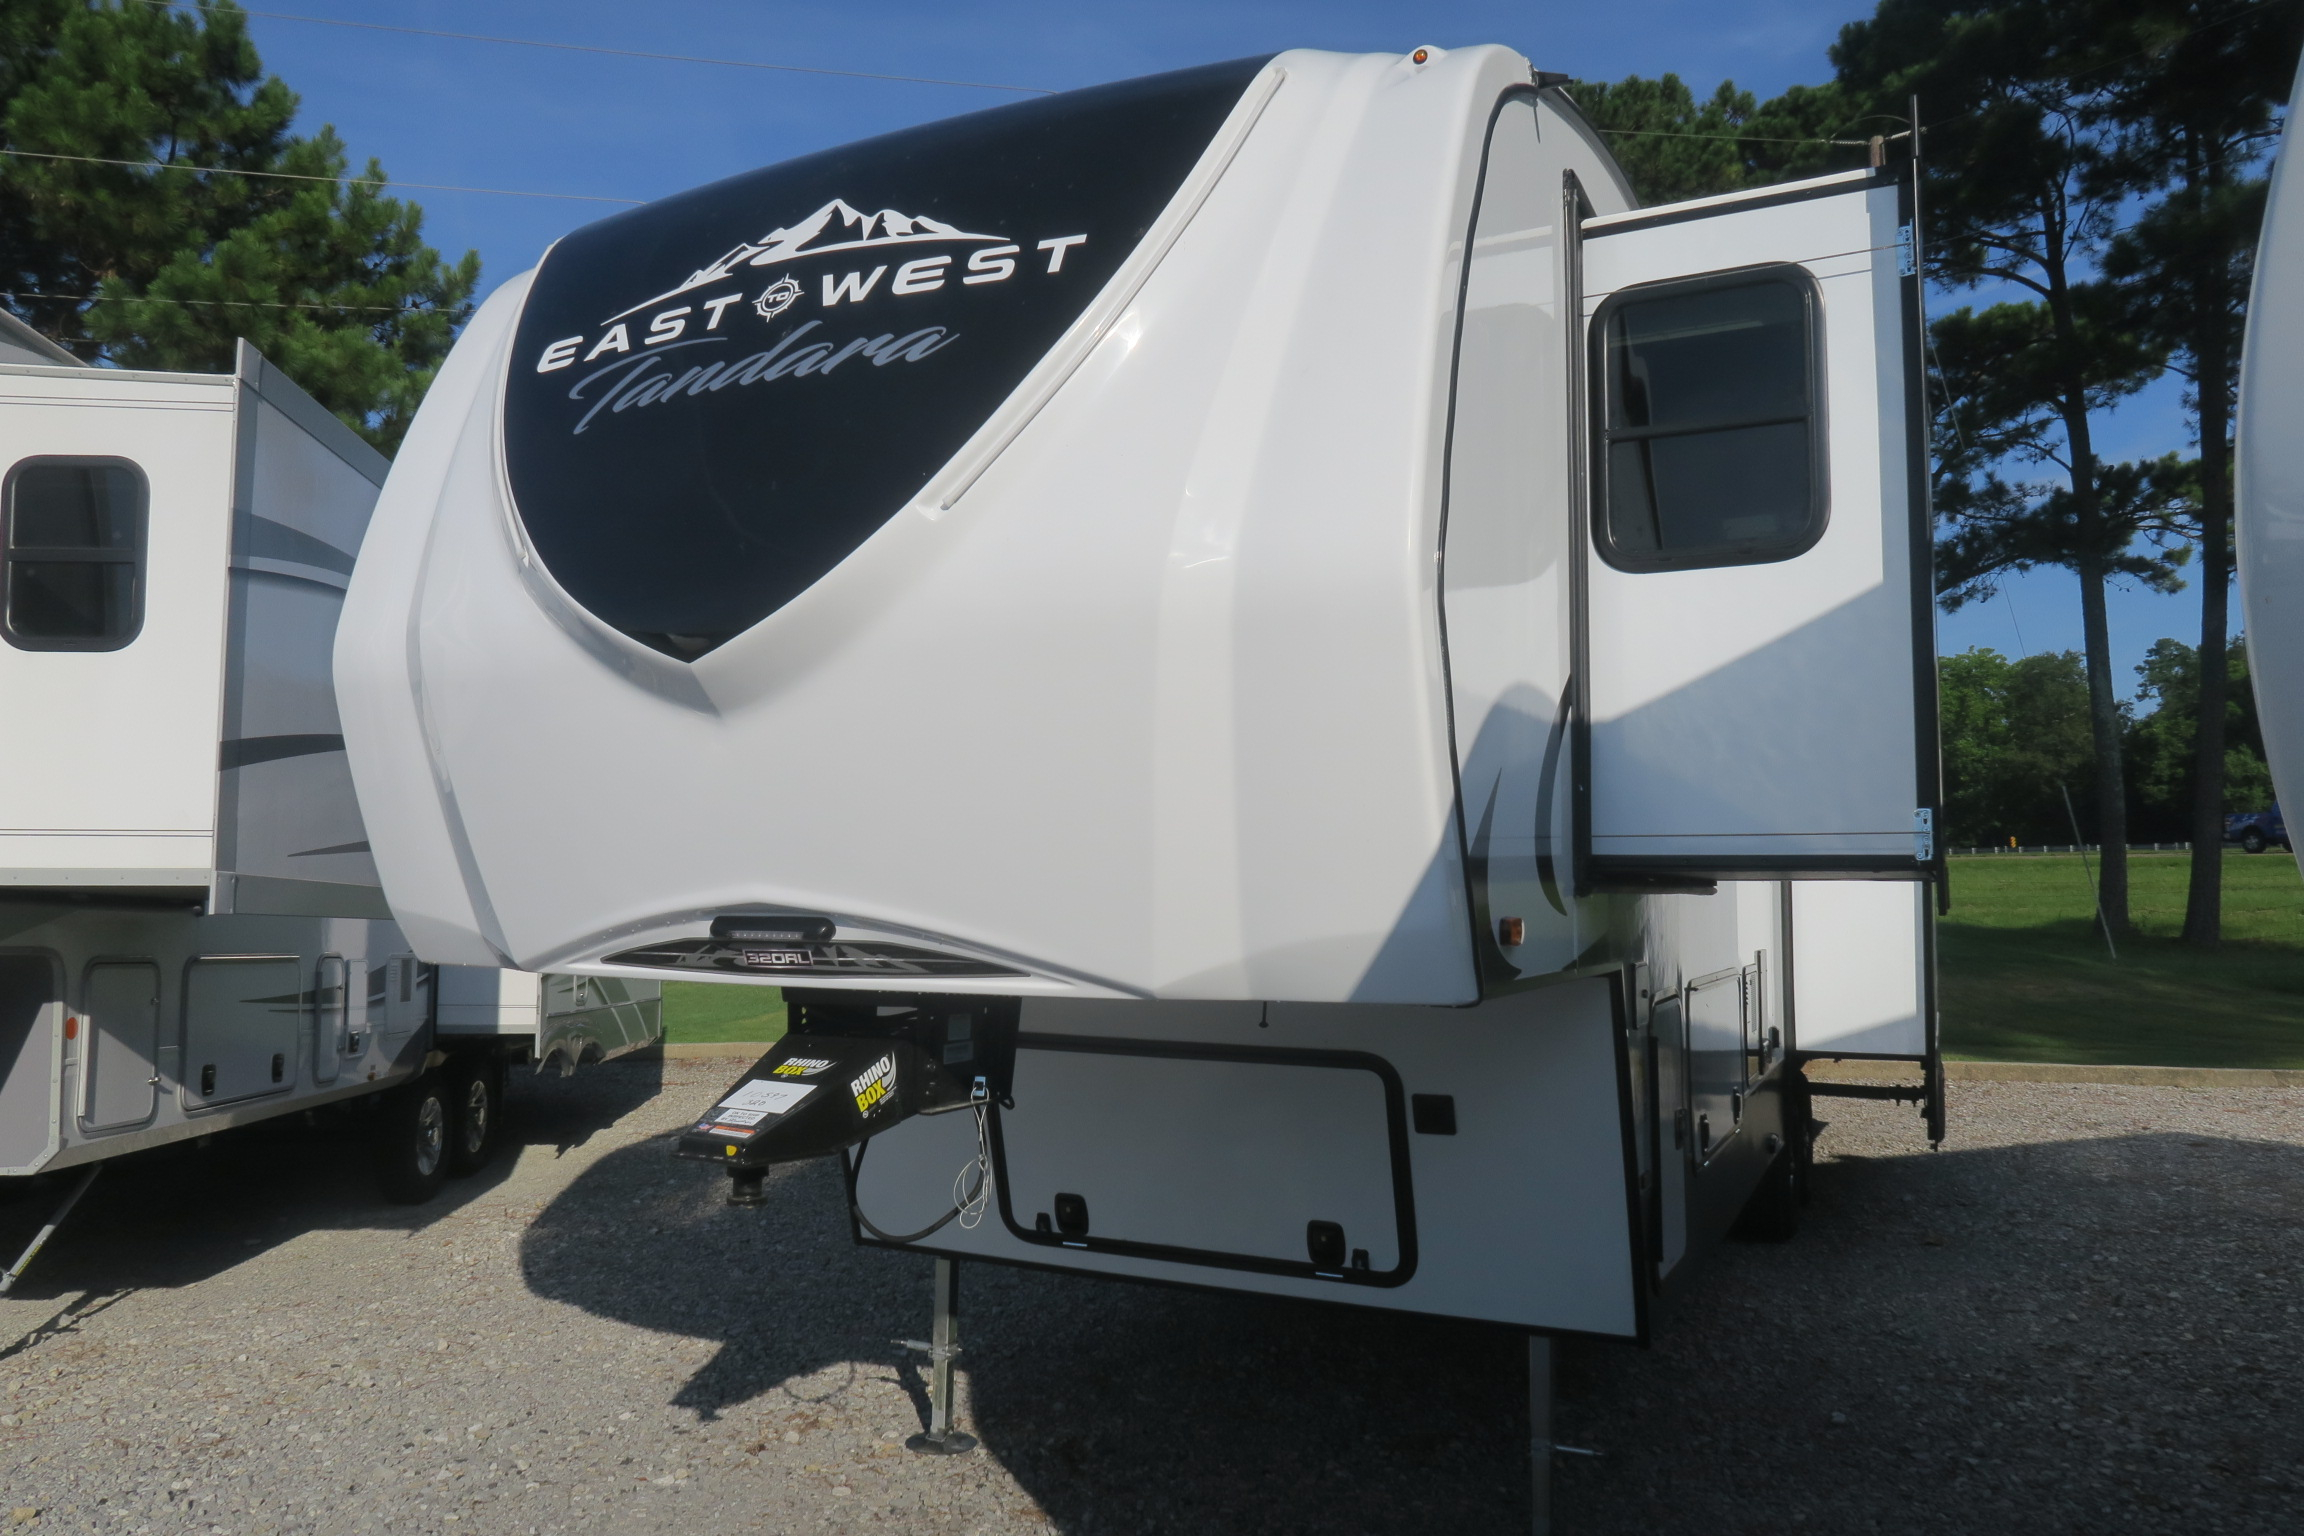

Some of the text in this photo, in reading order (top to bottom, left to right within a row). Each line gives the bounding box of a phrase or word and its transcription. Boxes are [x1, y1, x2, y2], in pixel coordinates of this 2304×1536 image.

[536, 233, 1088, 373] EAST TO WEST
[568, 320, 961, 435] Tandara
[747, 953, 810, 964] 320RL
[772, 1064, 808, 1076] BOX
[782, 1057, 830, 1068] RHINO
[850, 1056, 891, 1097] RHINO
[855, 1078, 888, 1113] BOX
